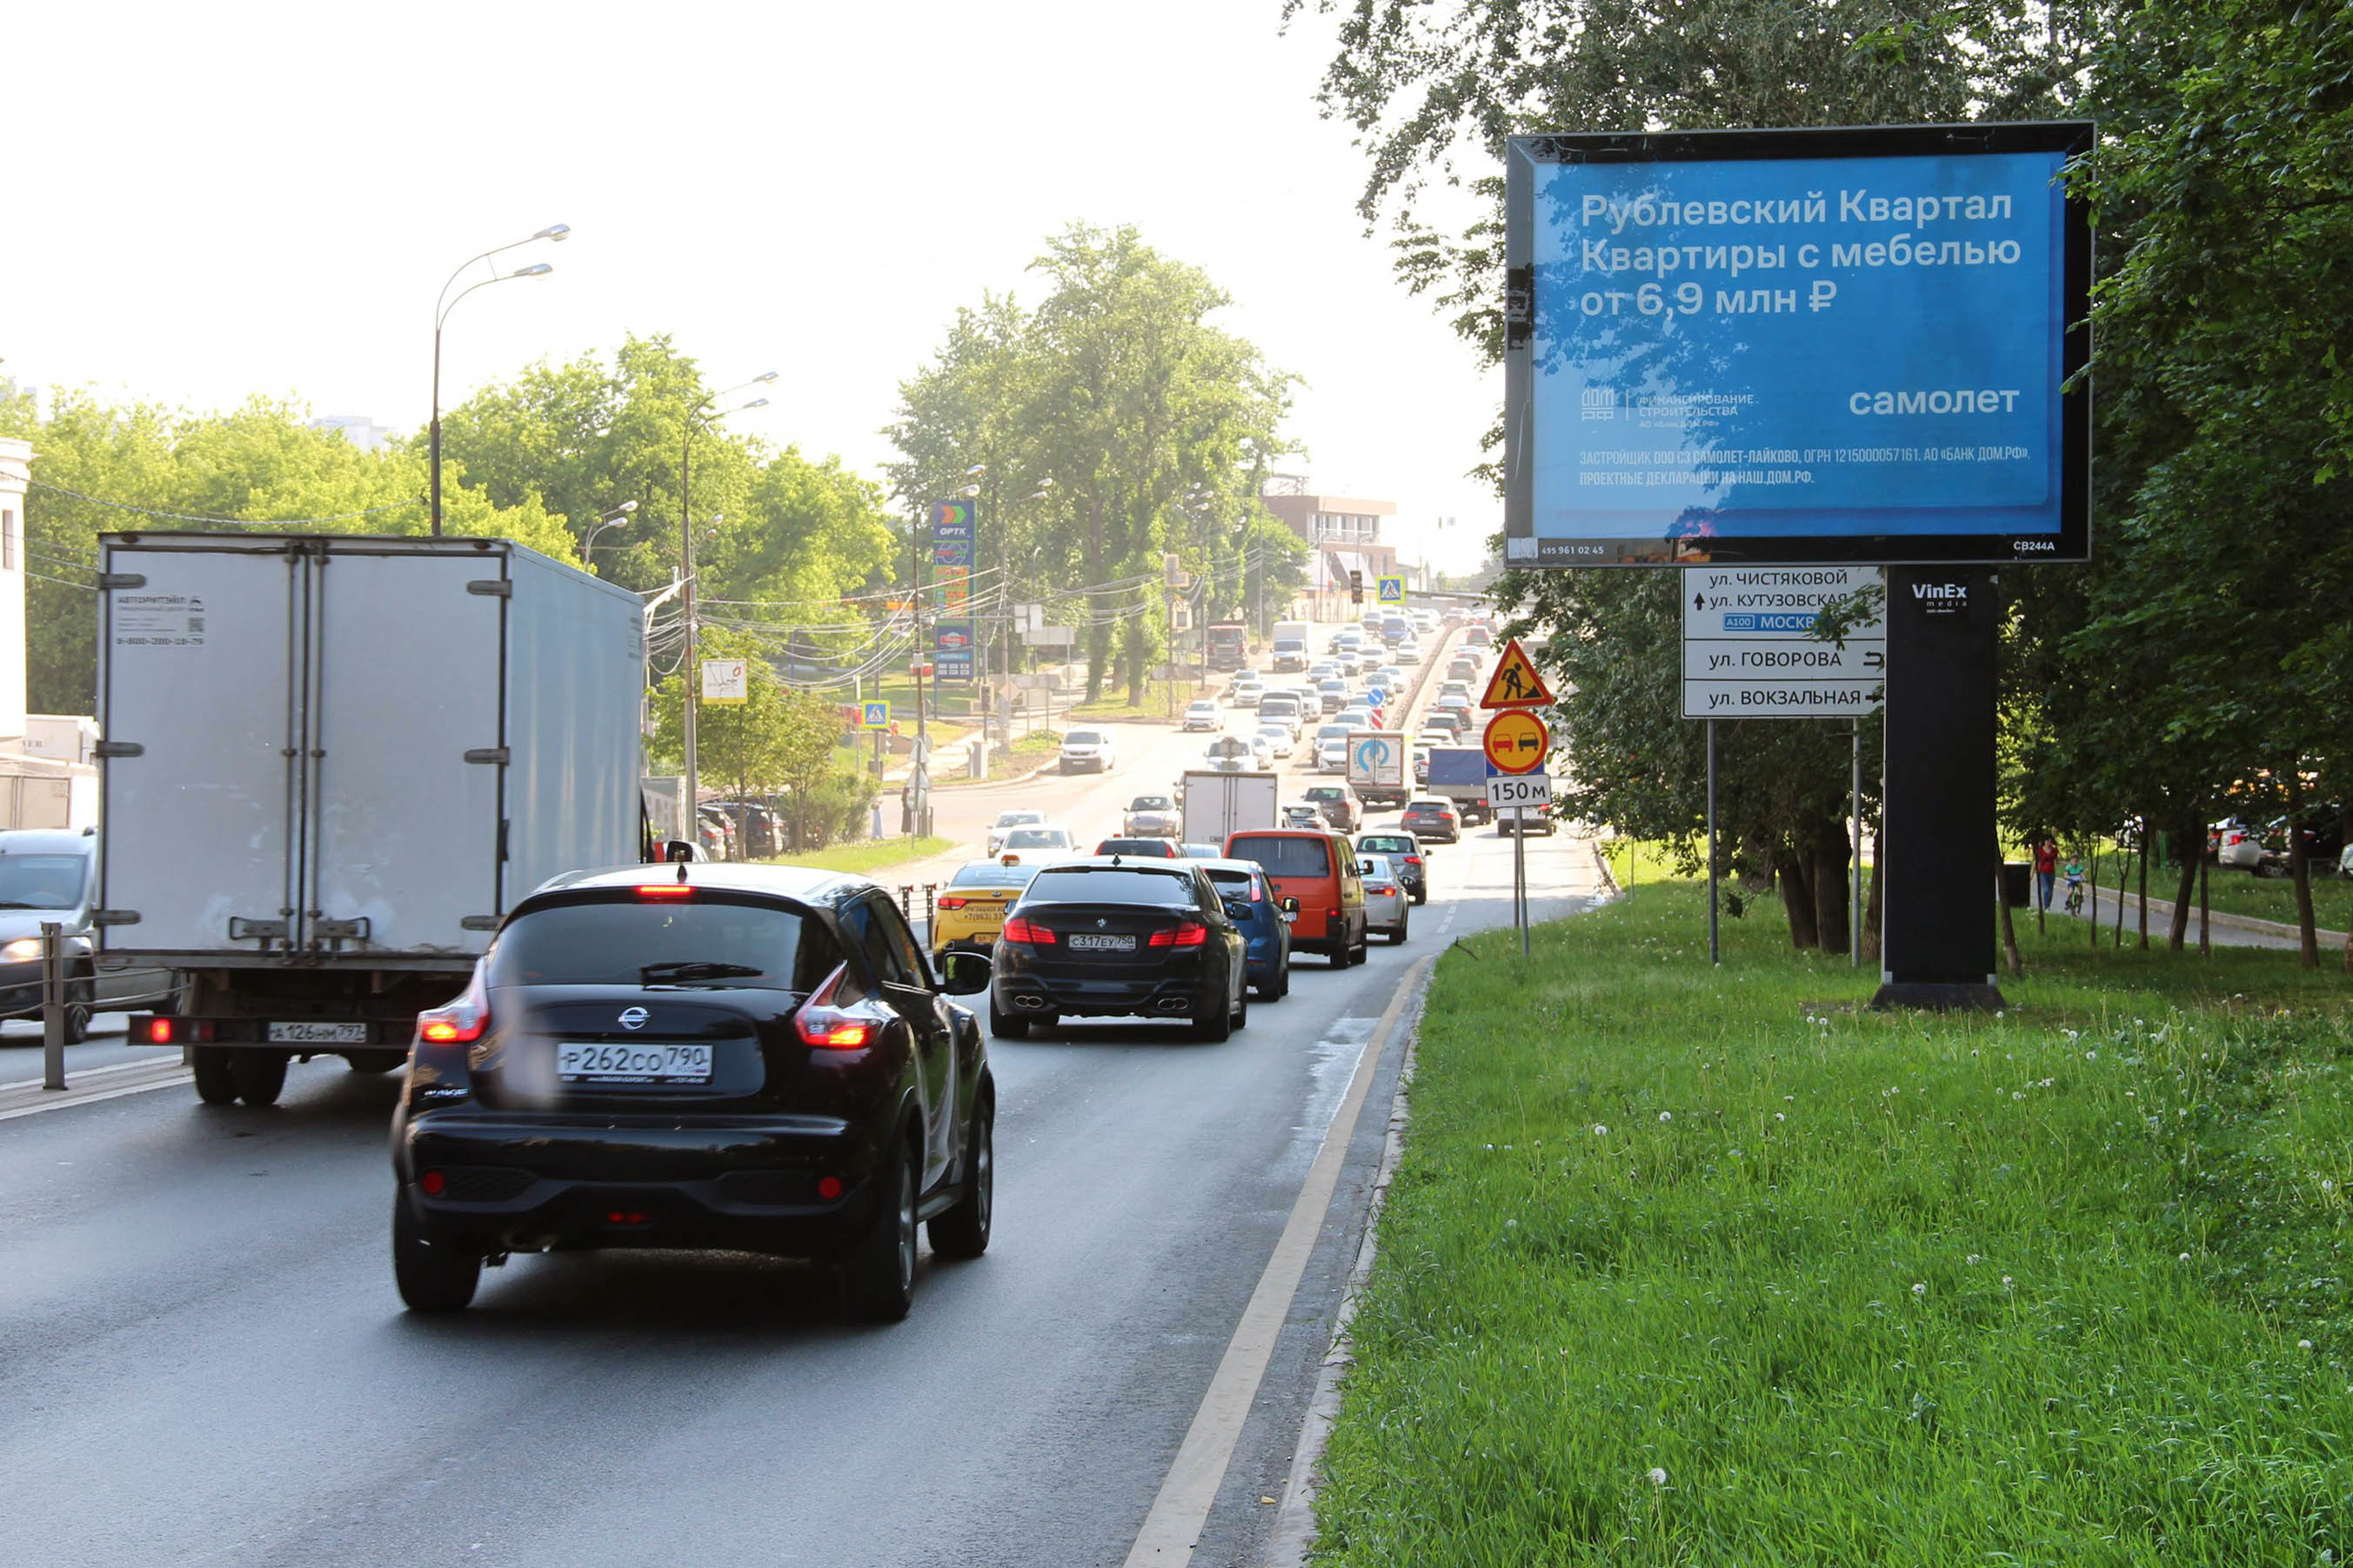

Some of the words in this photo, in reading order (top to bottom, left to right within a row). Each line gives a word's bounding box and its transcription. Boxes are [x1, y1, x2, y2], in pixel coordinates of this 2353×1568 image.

[1582, 190, 1826, 235] Рублевский
[1840, 189, 2011, 230] Квартал
[1582, 238, 1786, 279] Квартиры
[1798, 244, 1821, 269] с
[1832, 233, 2022, 267] мебелью
[1581, 290, 1626, 316] от
[1636, 282, 1703, 321] 6,9
[1716, 290, 1796, 314] млн
[1639, 393, 1755, 404] ФИНАНСИРОВАНИЕ
[1849, 390, 2020, 416] самолет
[1639, 405, 1739, 417] СТРОИТЕЛЬСТВА
[1580, 449, 1651, 466] ЗАСТРОЙЩИК
[1804, 449, 1831, 464] ОГРН
[1923, 447, 1938, 461] АО
[1580, 471, 1643, 486] ПРОЕКТНЫЕ
[1646, 470, 1719, 487] ДЕКЛАРАЦИИ
[1558, 545, 1575, 555] 961
[1578, 545, 1589, 555] 02
[1592, 545, 1604, 555] 45
[1709, 573, 1733, 589] ул.
[1736, 569, 1848, 585] ЧИСТЯКОВОЙ
[1912, 584, 1968, 599] VinEx
[1709, 595, 1733, 611] ул.
[1737, 592, 1848, 608] КУТУЗОВСКАЯ
[1760, 616, 1819, 630] МОСКВ
[1709, 654, 1735, 671] ул.
[1741, 651, 1842, 667] ГОВОРОВА
[1709, 693, 1735, 709] ул.
[1741, 690, 1862, 705] ВОКЗАЛЬНАЯ
